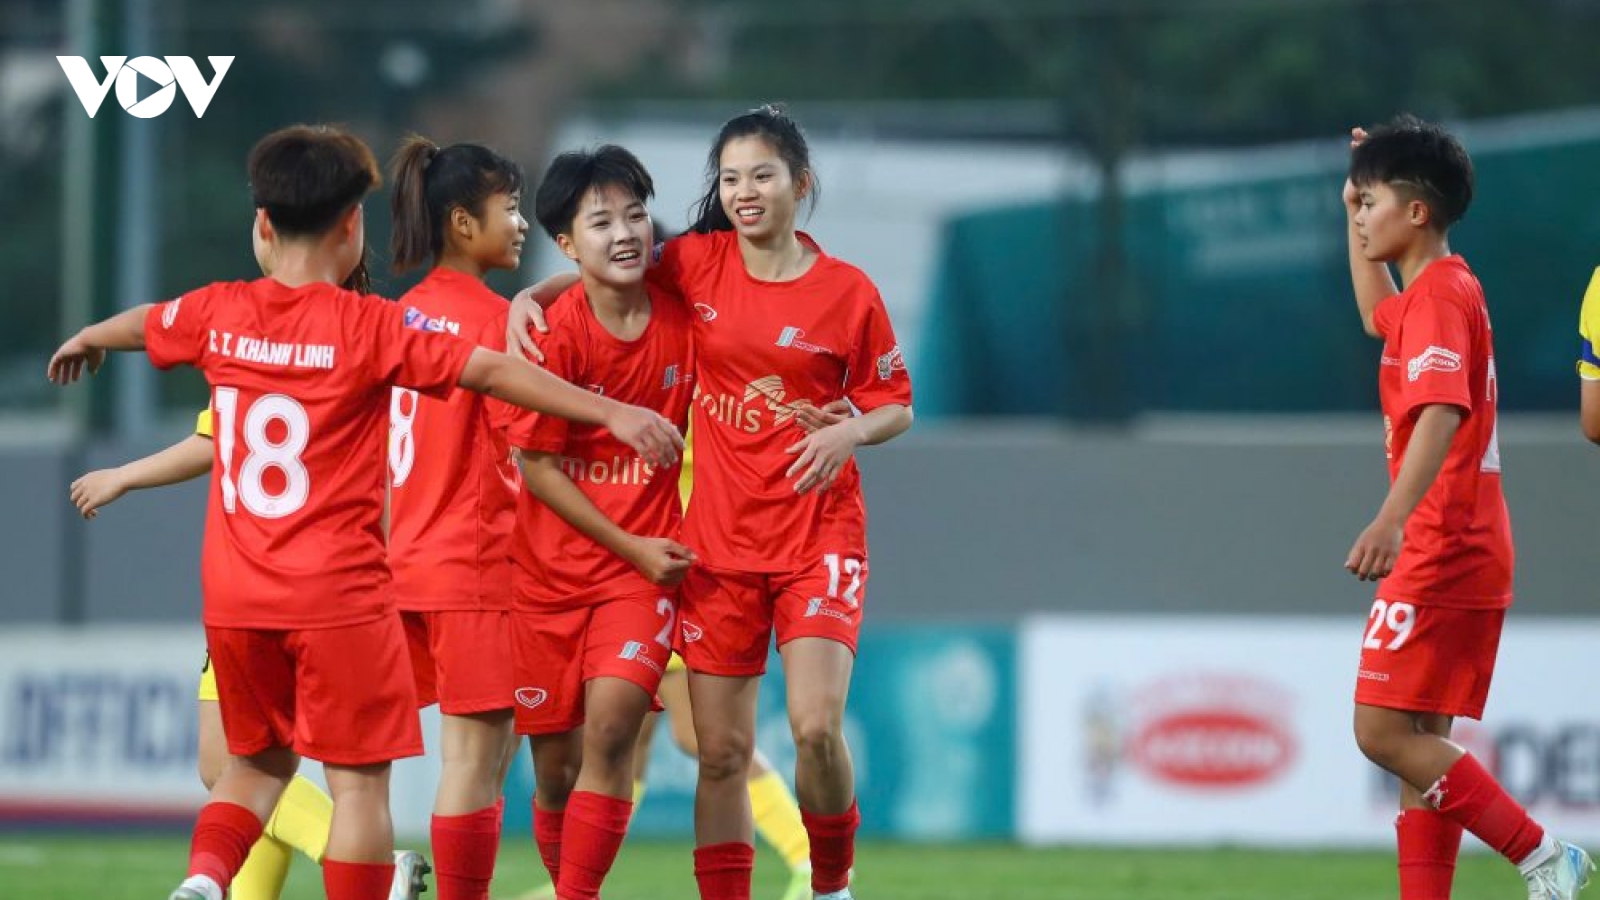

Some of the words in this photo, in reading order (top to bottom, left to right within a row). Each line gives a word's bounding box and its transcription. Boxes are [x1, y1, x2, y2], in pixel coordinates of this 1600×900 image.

[294, 344, 335, 369] LINH
[214, 386, 310, 519] 18
[823, 553, 862, 608] 12
[1363, 599, 1416, 651] 29
